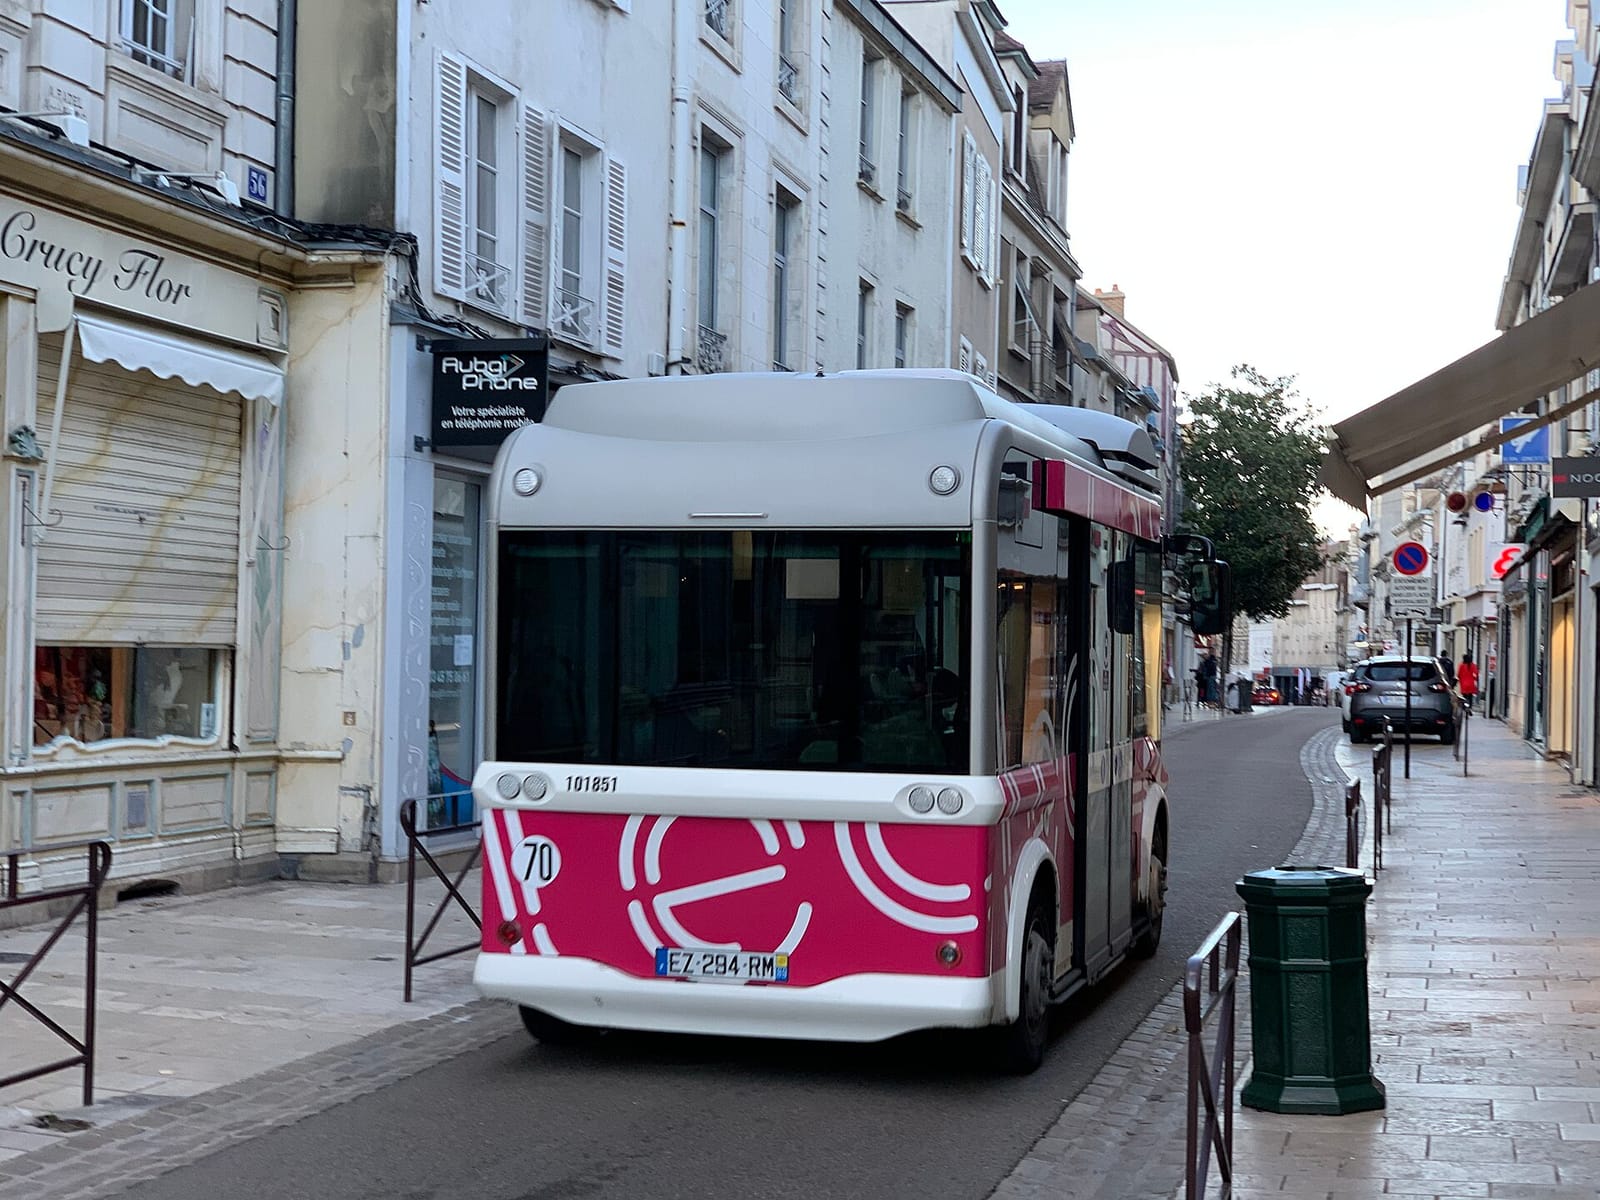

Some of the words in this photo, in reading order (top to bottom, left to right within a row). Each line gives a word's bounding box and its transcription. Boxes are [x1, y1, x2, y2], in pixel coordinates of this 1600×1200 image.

[249, 170, 266, 197] 56
[1, 211, 103, 295] Crucy
[114, 249, 192, 304] Flor
[462, 374, 538, 391] Phone
[450, 405, 476, 417] Votre
[477, 404, 526, 418] spécialiste
[440, 419, 454, 429] en
[454, 417, 503, 430] téléphonie
[565, 776, 618, 792] 101851
[523, 843, 553, 881] 70
